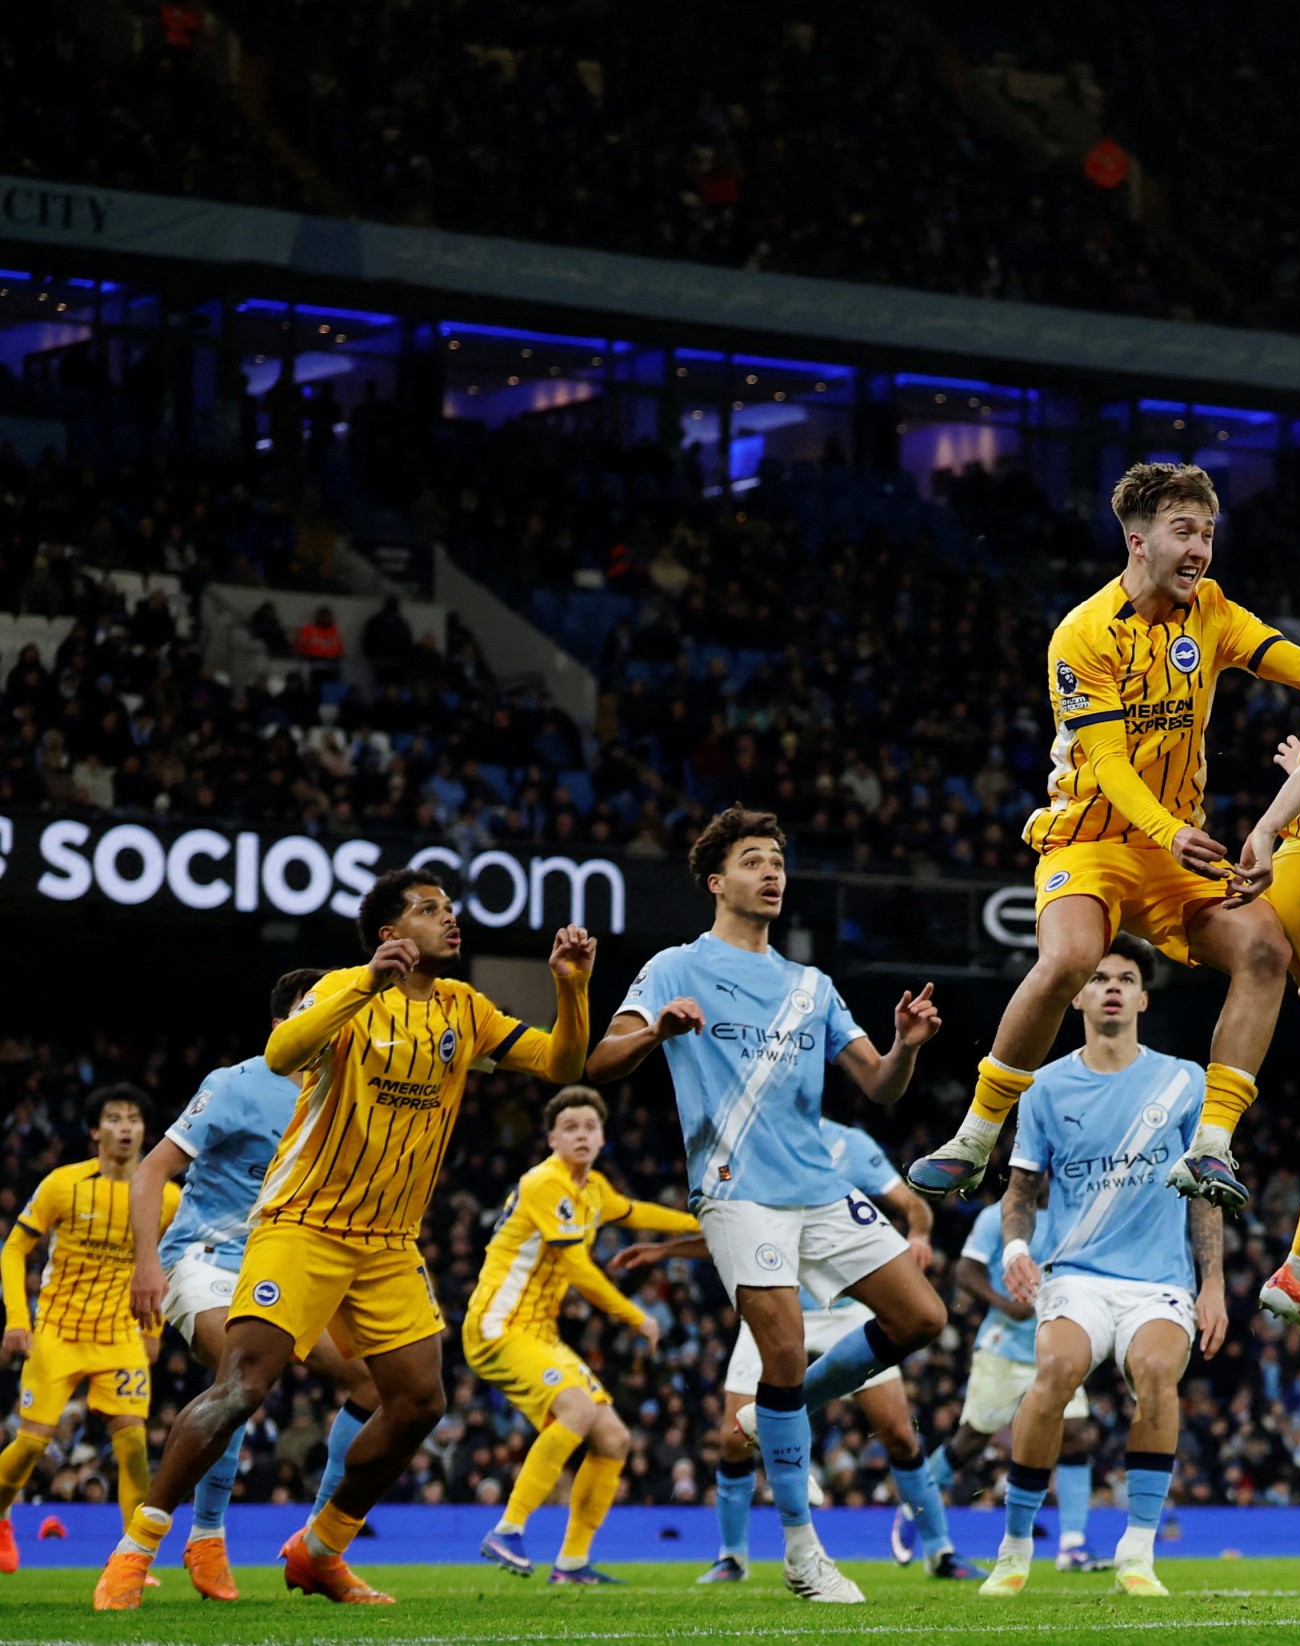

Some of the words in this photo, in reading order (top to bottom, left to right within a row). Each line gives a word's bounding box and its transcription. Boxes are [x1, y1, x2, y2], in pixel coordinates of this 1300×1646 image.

[1123, 697, 1193, 718] MERICAN
[711, 1022, 815, 1051] ETIHAD
[740, 1047, 799, 1066] AIRWAYS
[1064, 1147, 1169, 1179] ETIHAD
[1086, 1172, 1155, 1193] AIRWAYS
[845, 1194, 878, 1225] 6
[115, 1369, 147, 1396] 22
